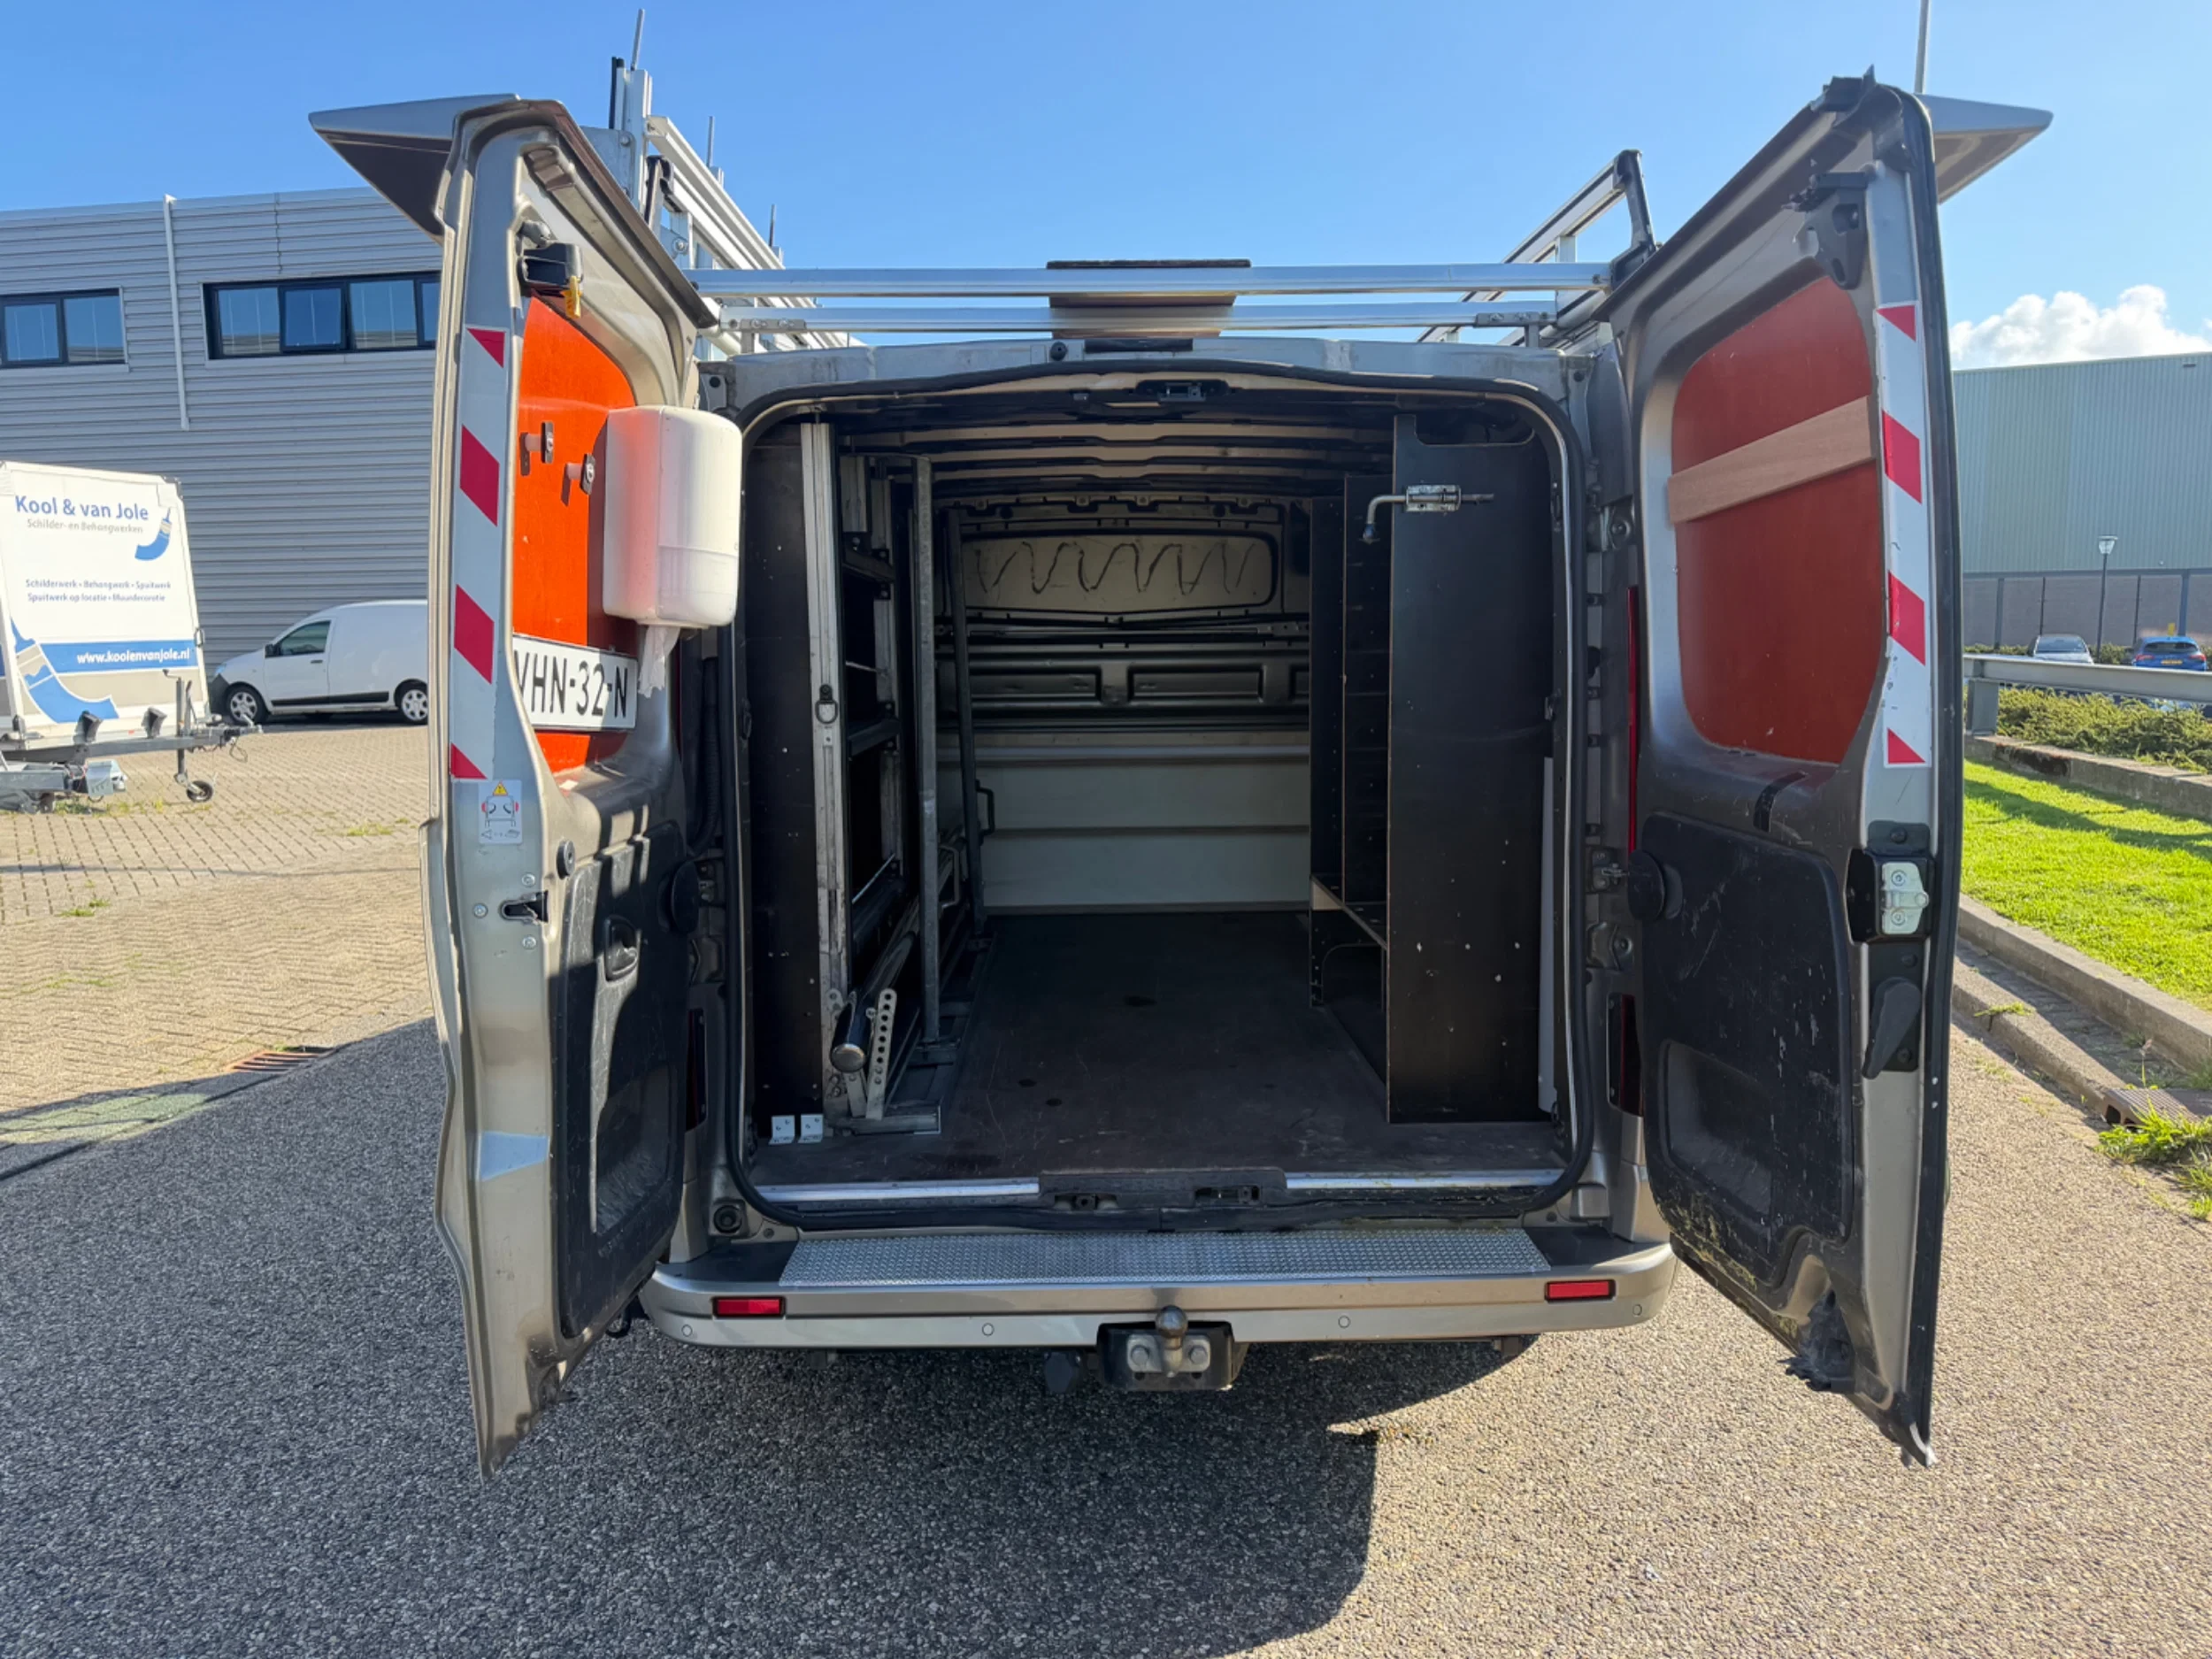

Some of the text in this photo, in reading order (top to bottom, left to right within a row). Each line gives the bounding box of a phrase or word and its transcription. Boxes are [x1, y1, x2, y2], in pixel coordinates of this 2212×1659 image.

[15, 495, 150, 520] Kool & van Jole
[27, 518, 66, 530] Schilder-
[81, 521, 143, 534] Behangwerken
[77, 648, 190, 664] www.koolenvanjole.nl
[514, 649, 628, 718] VHN-32-N
